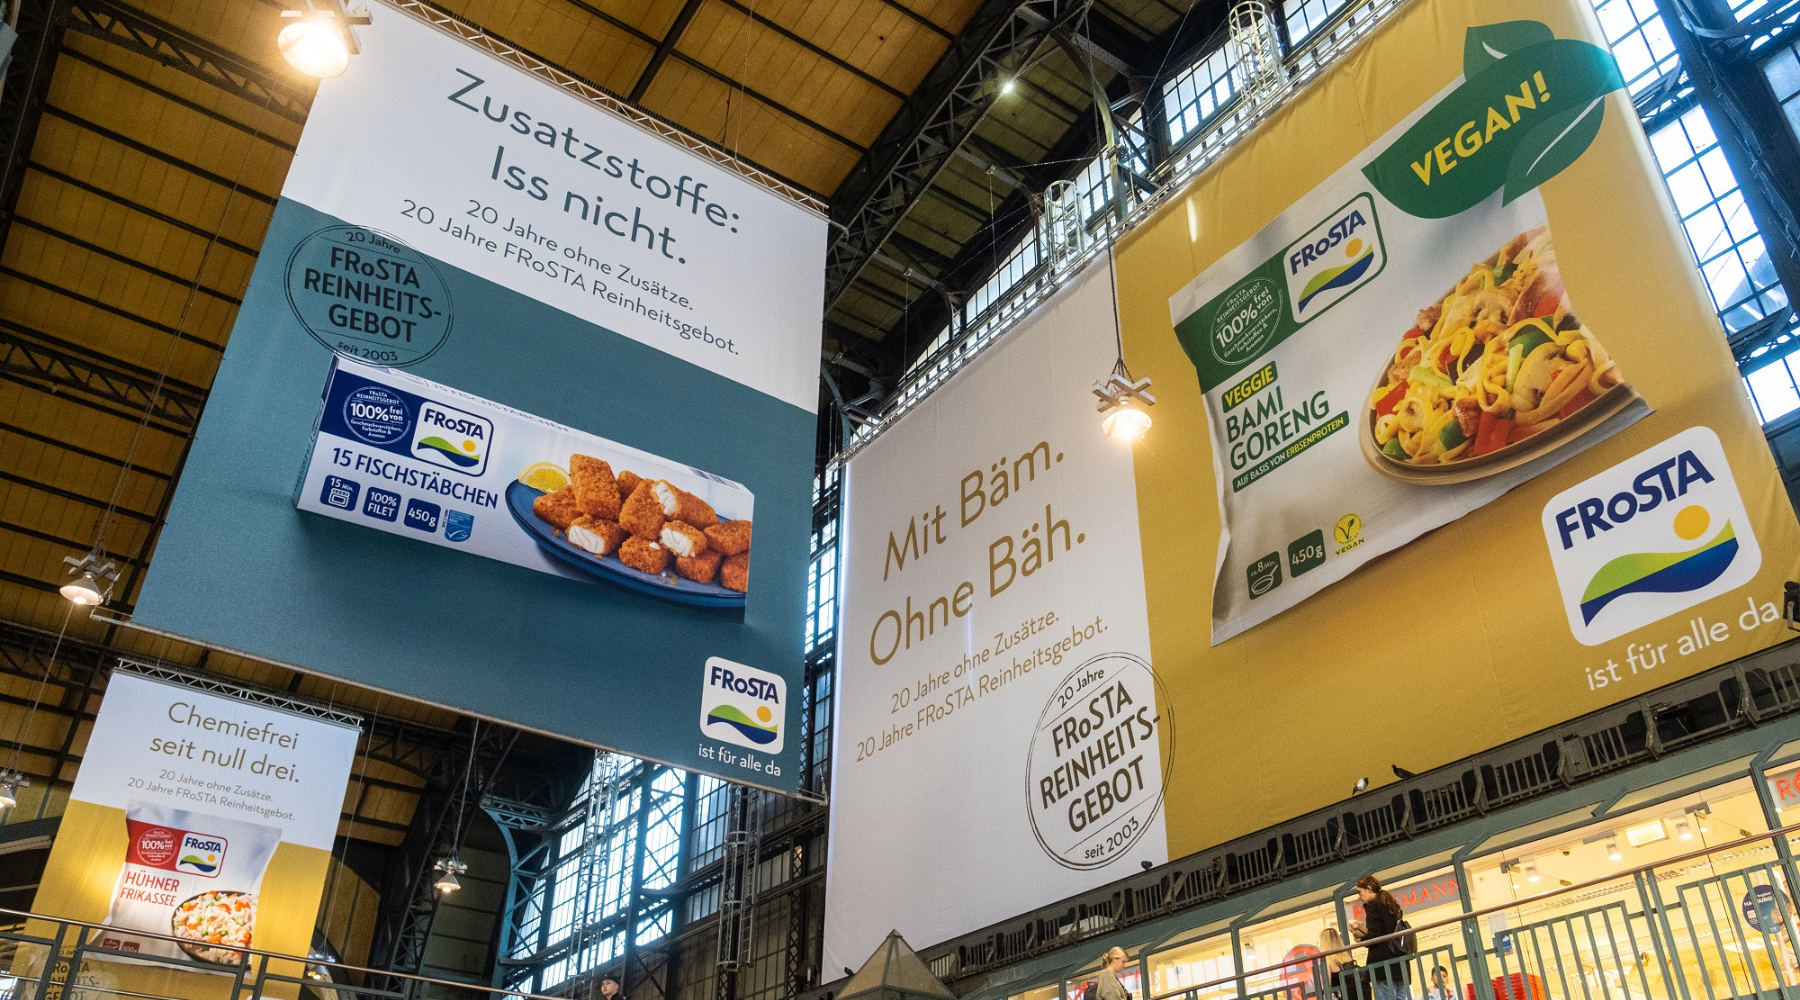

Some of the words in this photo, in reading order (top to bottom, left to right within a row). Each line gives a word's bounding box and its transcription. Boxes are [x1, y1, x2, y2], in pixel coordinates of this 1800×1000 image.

[447, 67, 740, 234] Zusatzstoffe:
[1410, 70, 1551, 187] VEGAN!
[490, 145, 550, 202] Iss
[563, 189, 686, 265] nicht.
[345, 232, 365, 243] 20
[369, 235, 401, 254] Jahre
[467, 199, 498, 224] 20
[503, 217, 558, 251] Jahre
[564, 245, 612, 275] ohne
[616, 264, 694, 311] Zusätze.
[1289, 209, 1367, 276] FRoSTA
[331, 246, 420, 289] FRoSTA
[400, 199, 435, 225] 20
[439, 217, 498, 253] Jahre
[503, 244, 587, 292] FRoSTA
[592, 280, 739, 356] Reinheitsgebot.
[304, 267, 442, 319] REINHEITS-
[1253, 286, 1269, 304] frei
[1256, 294, 1273, 310] von
[328, 304, 417, 342] GEBOT
[1216, 303, 1258, 349] 100%
[337, 341, 360, 356] seit
[362, 348, 398, 361] 2003
[1224, 364, 1275, 408] VEGGIE
[350, 402, 389, 422] 100%
[389, 405, 403, 416] frei
[424, 408, 484, 440] FRoSTA
[1226, 385, 1284, 444] BAMI
[1230, 390, 1330, 471] GORENG
[1236, 475, 1250, 489] AUF
[1250, 461, 1270, 480] BASIS
[1269, 452, 1286, 467] VON
[1285, 416, 1344, 458] ERBSENPROTEIN
[330, 477, 341, 487] 15
[333, 447, 352, 467] 15
[354, 453, 498, 509] FISCHSTÄBCHEN
[370, 491, 397, 507] 100%
[1555, 449, 1715, 551] FRoSTA
[367, 502, 394, 518] FILET
[883, 504, 947, 582] Mit
[960, 441, 1064, 529] Bäm.
[1257, 561, 1264, 573] 8
[1335, 538, 1364, 555] VEGAN
[869, 581, 974, 666] Ohne
[988, 503, 1086, 599] Bäh.
[890, 687, 910, 714] 20
[913, 669, 950, 702] Jahre
[954, 648, 990, 679] ohne
[994, 611, 1060, 656] Zusätze.
[1584, 660, 1622, 691] ist
[1626, 643, 1669, 675] für
[1678, 616, 1729, 656] alle
[1738, 596, 1780, 631] da
[710, 665, 780, 705] FRoSTA
[856, 737, 875, 763] 20
[877, 718, 914, 751] Jahre
[917, 690, 976, 733] FRoSTA
[979, 615, 1108, 698] Reinheitsgebot.
[1057, 686, 1074, 709] 20
[1076, 668, 1105, 693] Jahre
[168, 701, 300, 750] Chemiefrei
[1051, 680, 1133, 758] FRoSTA
[149, 735, 197, 760] seit
[202, 747, 247, 771] null
[250, 754, 300, 783] drei.
[698, 744, 715, 760] ist
[718, 746, 737, 765] für
[740, 754, 762, 772] alle
[765, 760, 781, 777] da
[1040, 705, 1161, 810] REINHEITS-
[127, 777, 144, 789] 20
[145, 781, 174, 797] Jahre
[175, 787, 217, 805] FRoSTA
[219, 796, 295, 821] Reinheitsgebot.
[159, 769, 176, 781] 20
[177, 773, 205, 788] Jahre
[206, 780, 232, 793] ohne
[233, 784, 273, 802] Zusätze.
[1068, 754, 1144, 833] GEBOT
[142, 840, 165, 850] 100%
[185, 837, 221, 853] FRoSTA
[1084, 844, 1105, 859] seit
[1106, 815, 1140, 853] 2003
[120, 887, 177, 907] FRIKASSEE
[125, 870, 180, 892] HÜHNER
